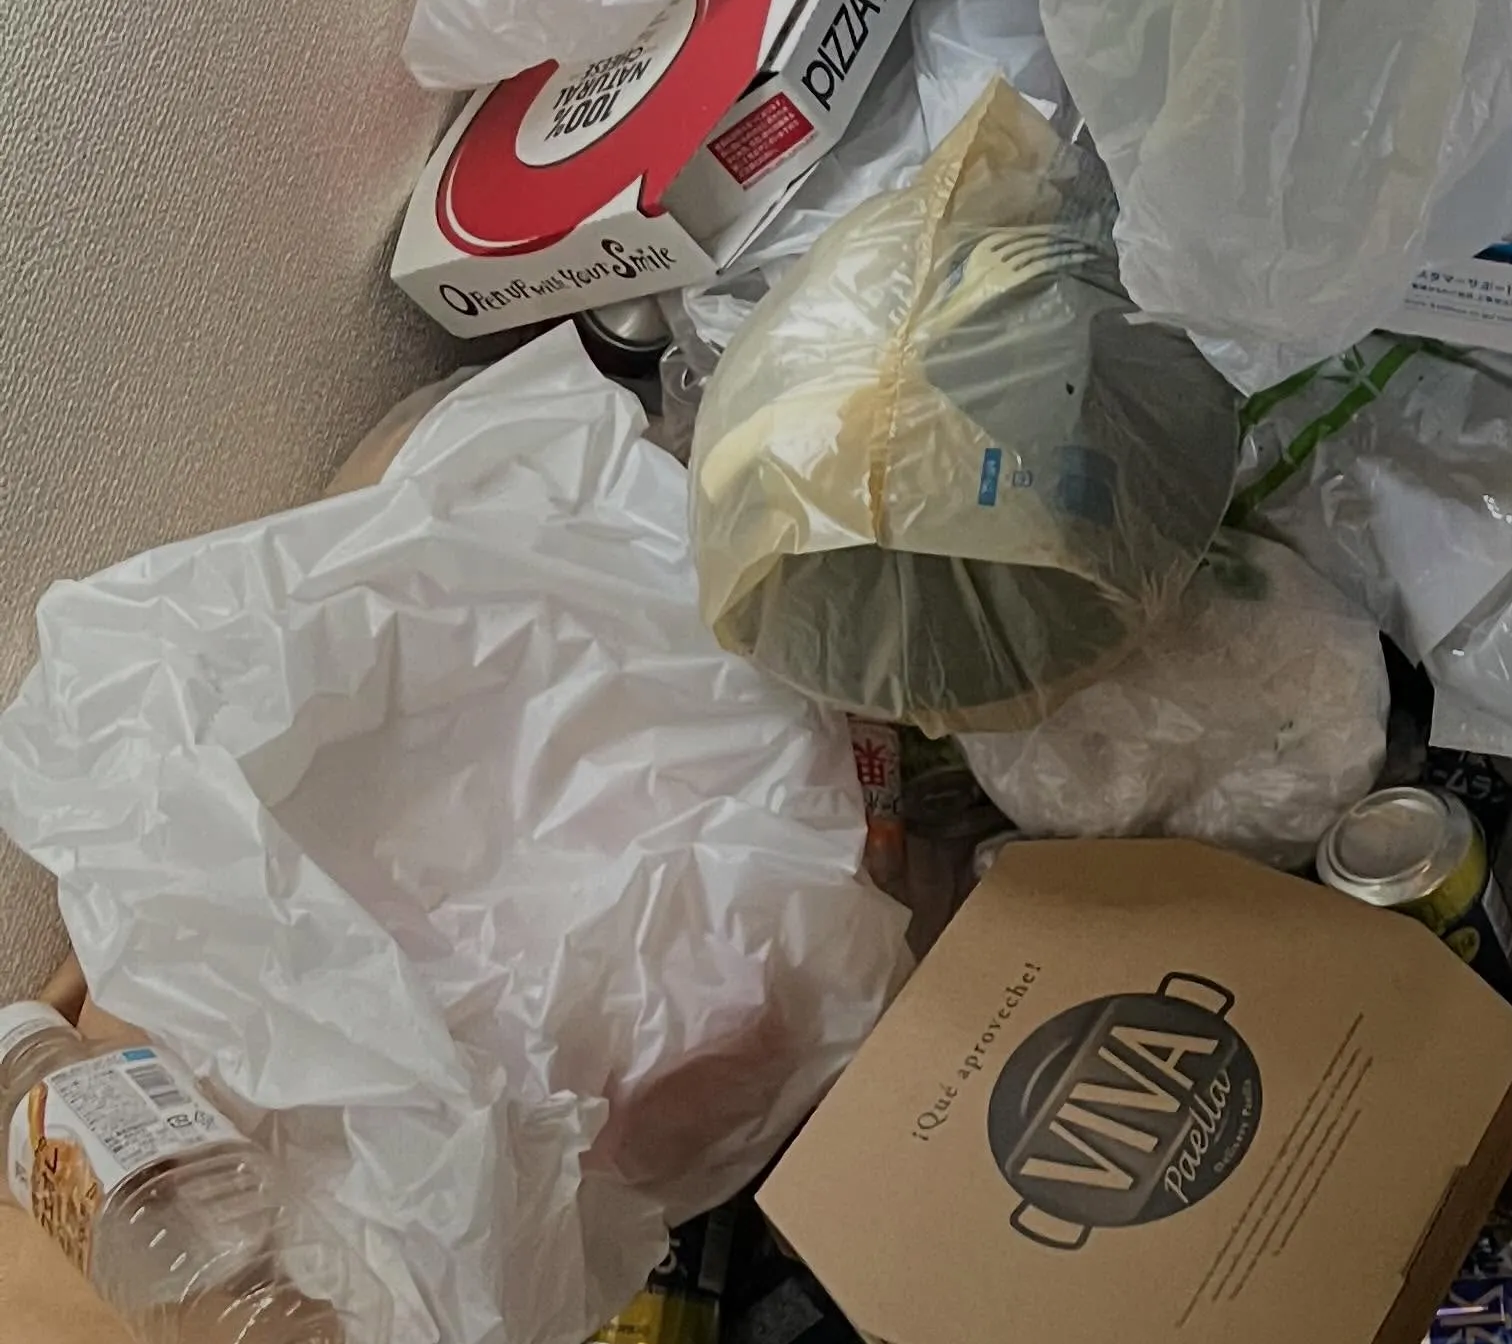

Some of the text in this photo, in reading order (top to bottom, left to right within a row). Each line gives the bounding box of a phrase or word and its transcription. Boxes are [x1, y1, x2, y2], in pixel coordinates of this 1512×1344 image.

[957, 960, 1043, 1083] aproveche!
[1018, 1025, 1221, 1191] VIVA
[1164, 1065, 1235, 1205] Paella
